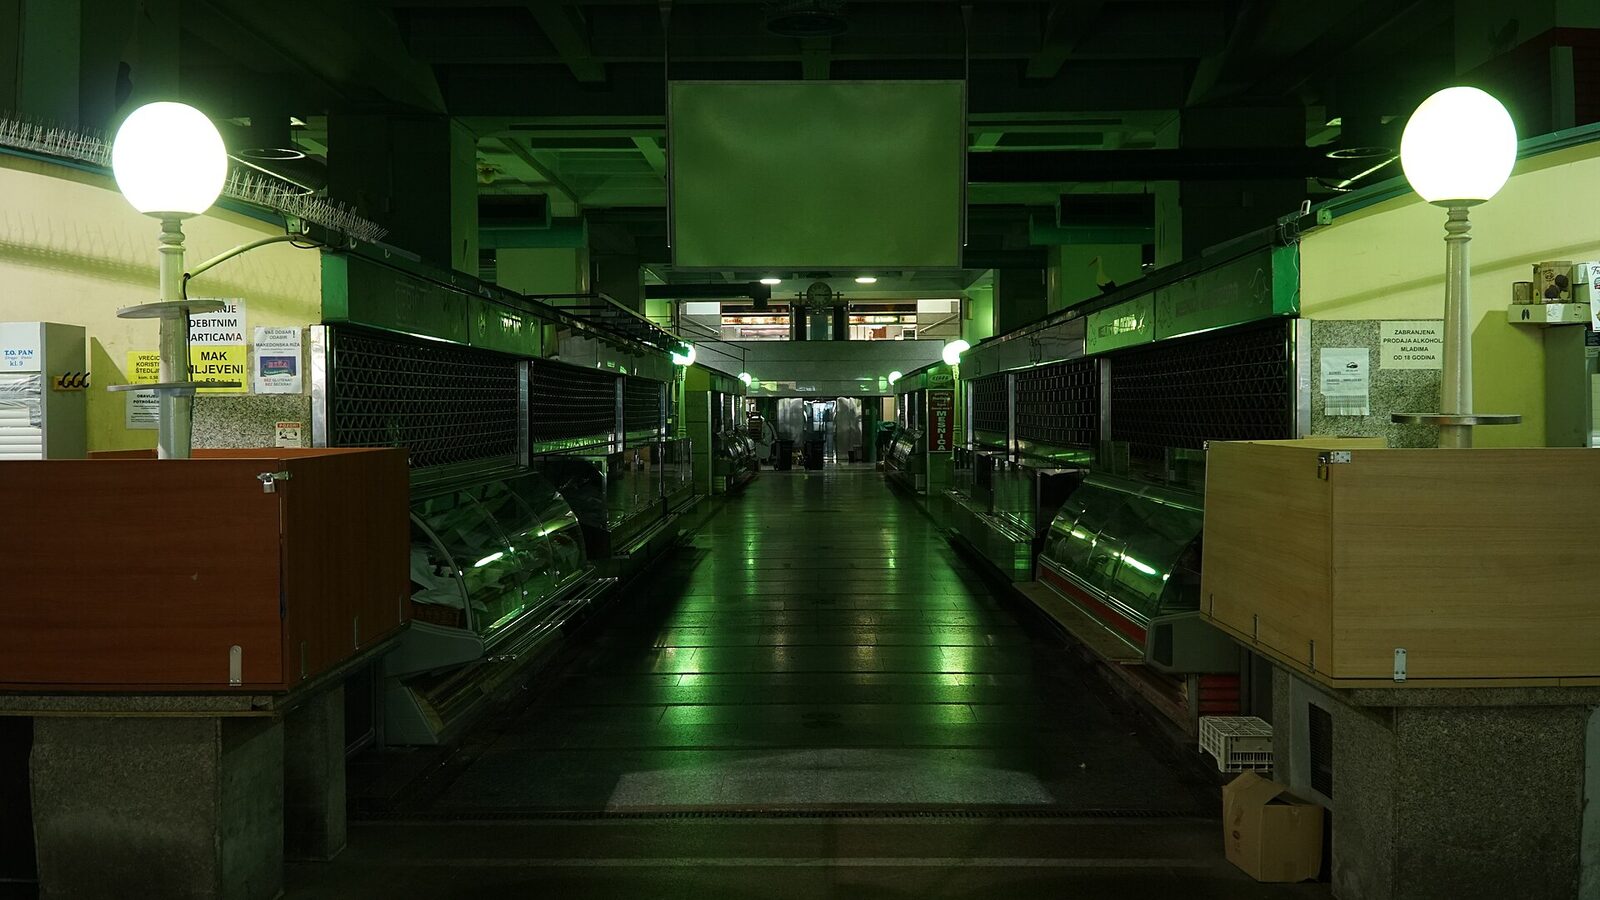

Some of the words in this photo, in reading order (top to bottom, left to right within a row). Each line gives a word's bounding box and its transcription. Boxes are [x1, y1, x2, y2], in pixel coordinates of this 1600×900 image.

[189, 319, 237, 327] DEBITNIM
[190, 333, 243, 341] ARTICAMA
[200, 352, 227, 361] MAK
[936, 410, 947, 451] MESNICA
